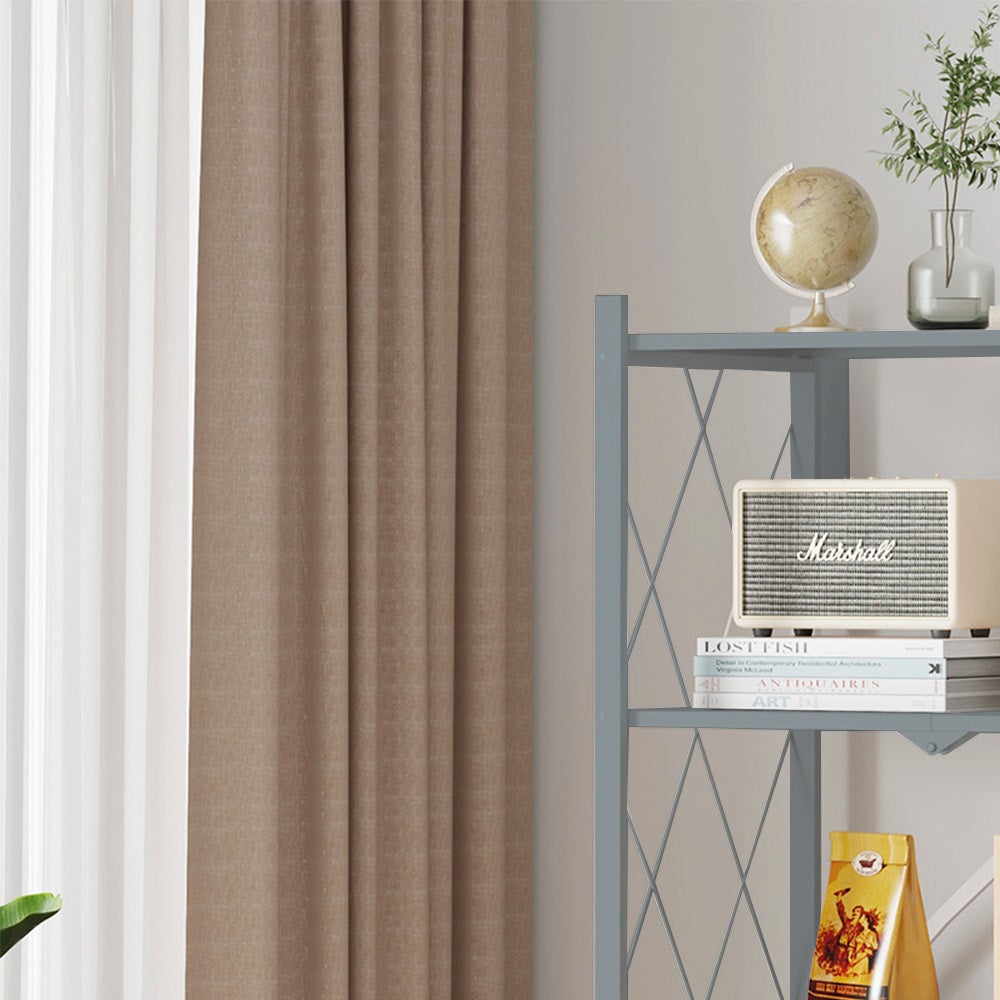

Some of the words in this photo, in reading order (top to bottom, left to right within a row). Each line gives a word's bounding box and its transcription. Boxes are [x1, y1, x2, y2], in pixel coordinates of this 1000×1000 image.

[797, 532, 895, 563] Marshall
[704, 641, 757, 654] LOST
[763, 641, 808, 654] FISH
[758, 679, 880, 690] ANTIQUAIRES
[752, 696, 790, 708] ART
